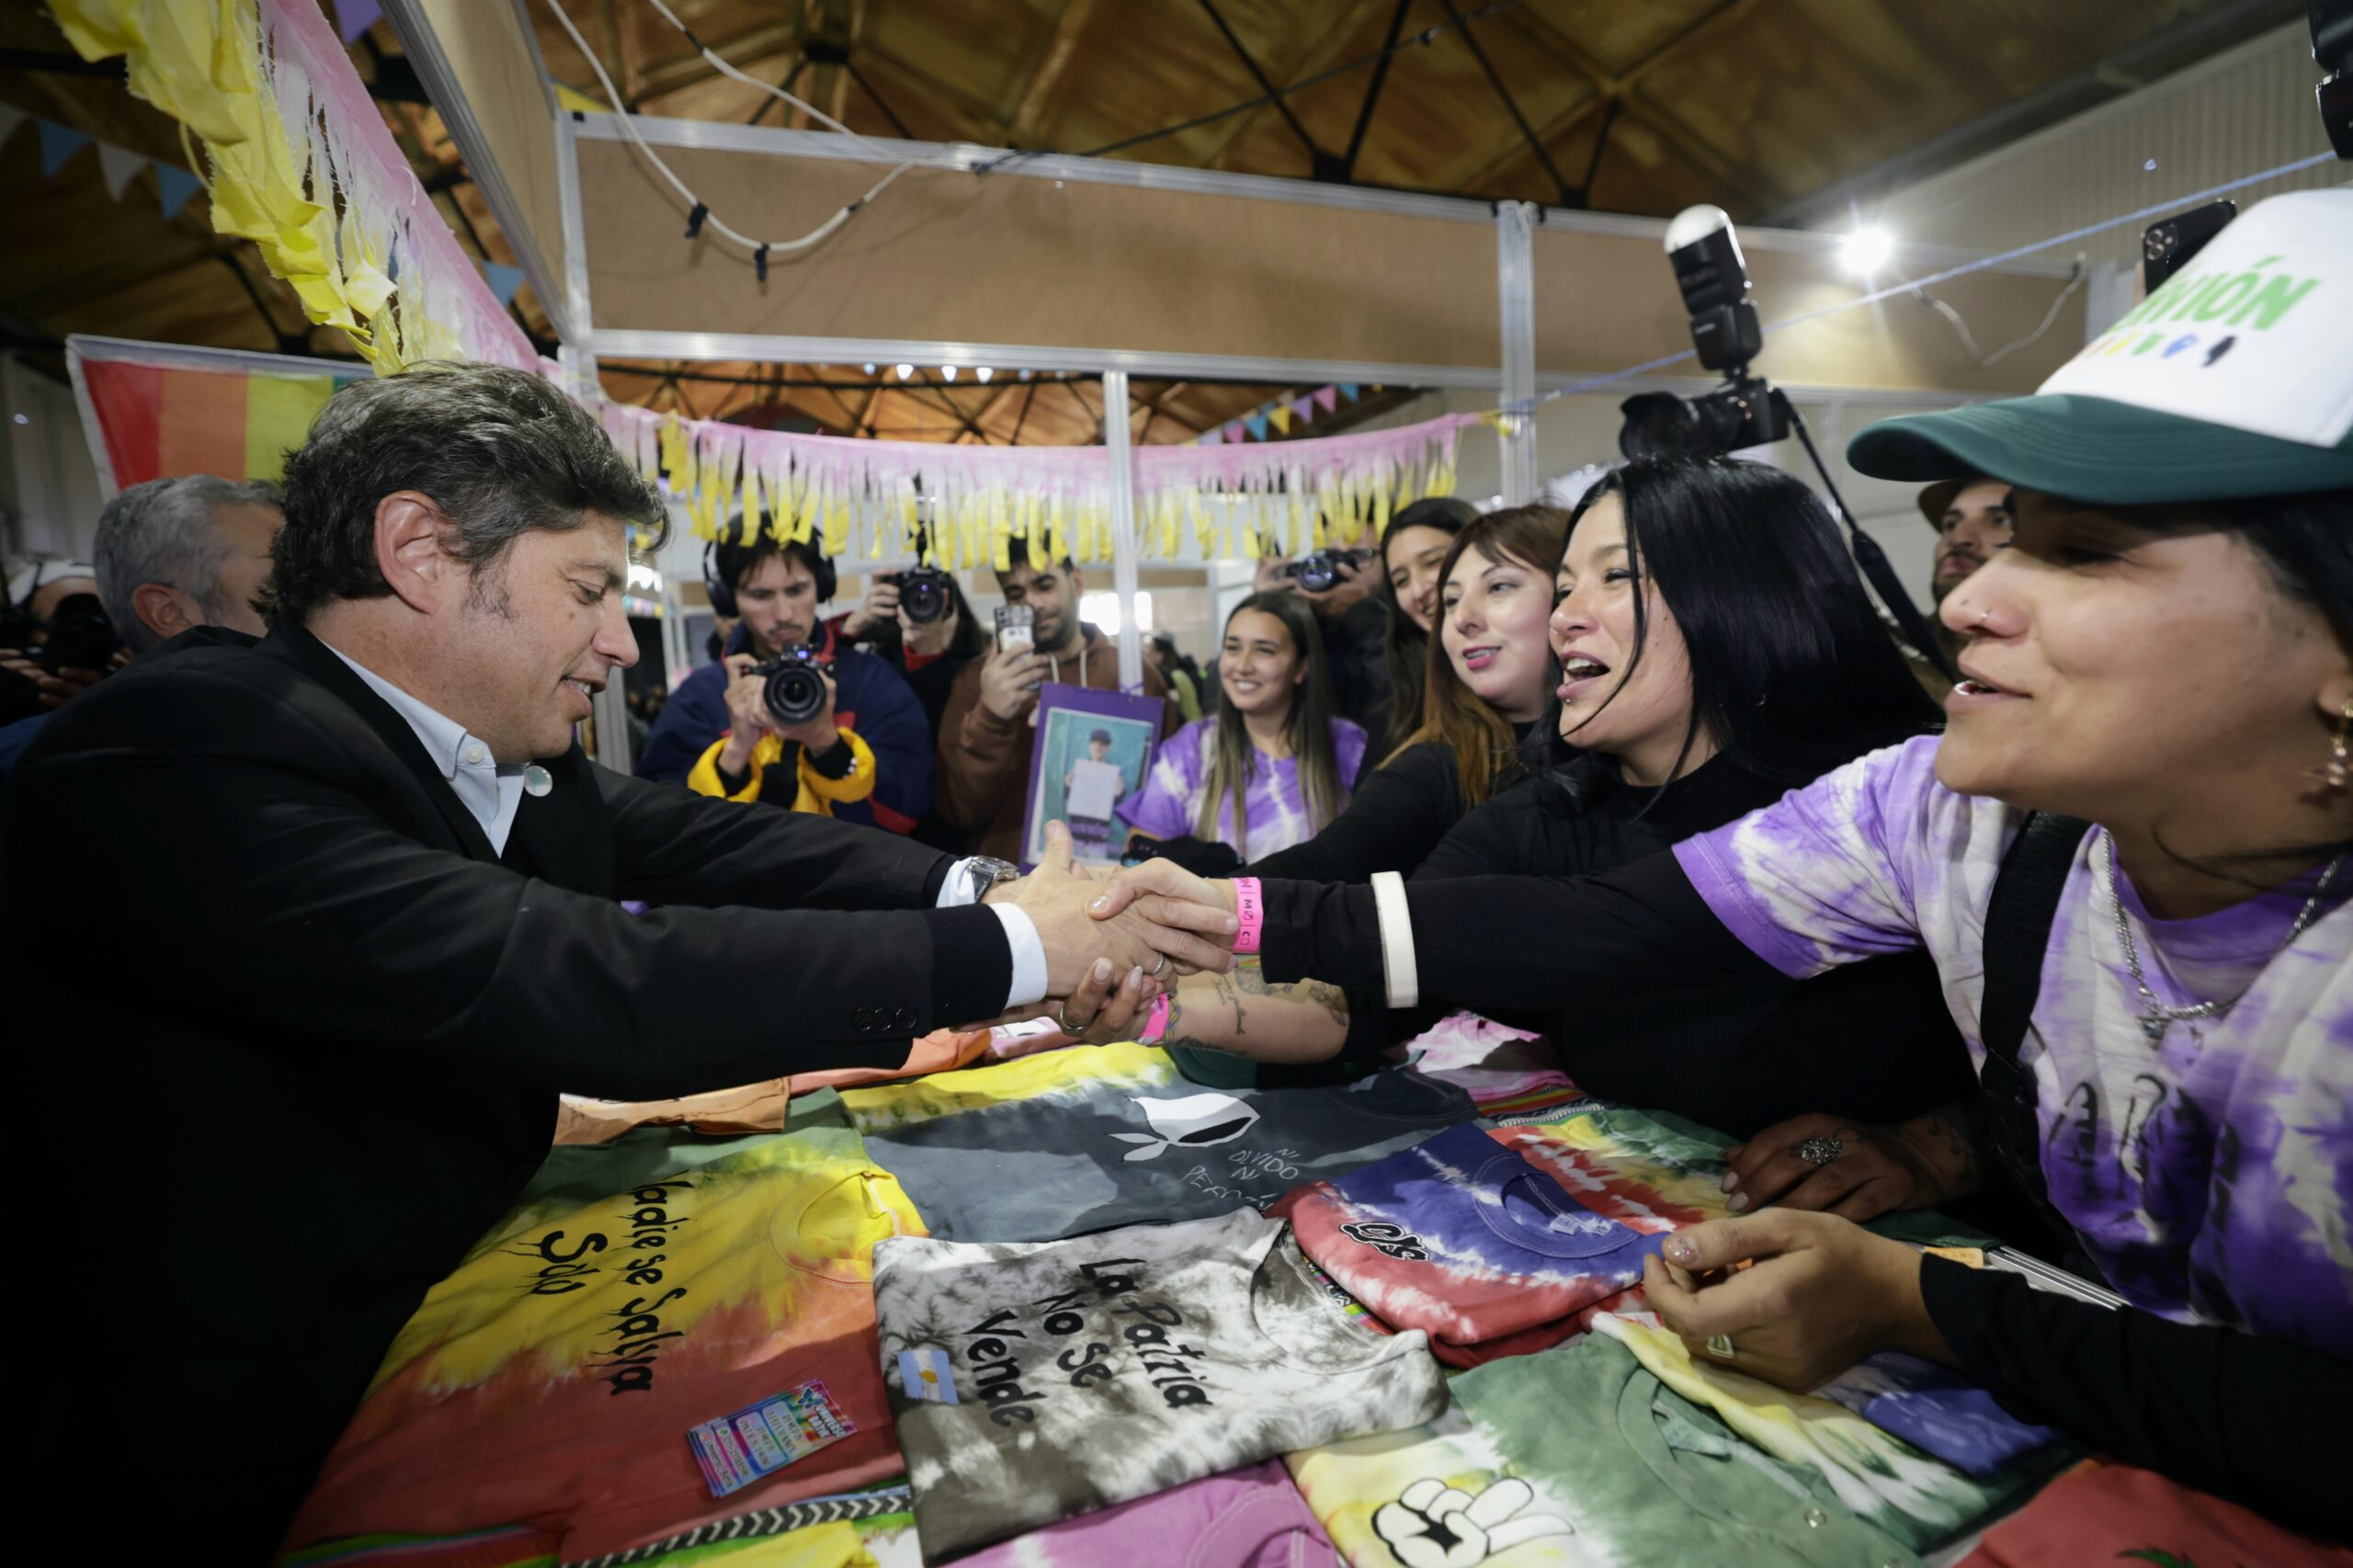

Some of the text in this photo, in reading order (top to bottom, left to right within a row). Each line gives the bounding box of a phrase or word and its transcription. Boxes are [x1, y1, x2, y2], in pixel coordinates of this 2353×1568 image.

[1228, 1150, 1299, 1179] OLVIDO
[588, 1287, 688, 1397] Salva
[1031, 1290, 1089, 1335] No
[1079, 1257, 1214, 1409] La Patria
[961, 1310, 1049, 1426] Vende
